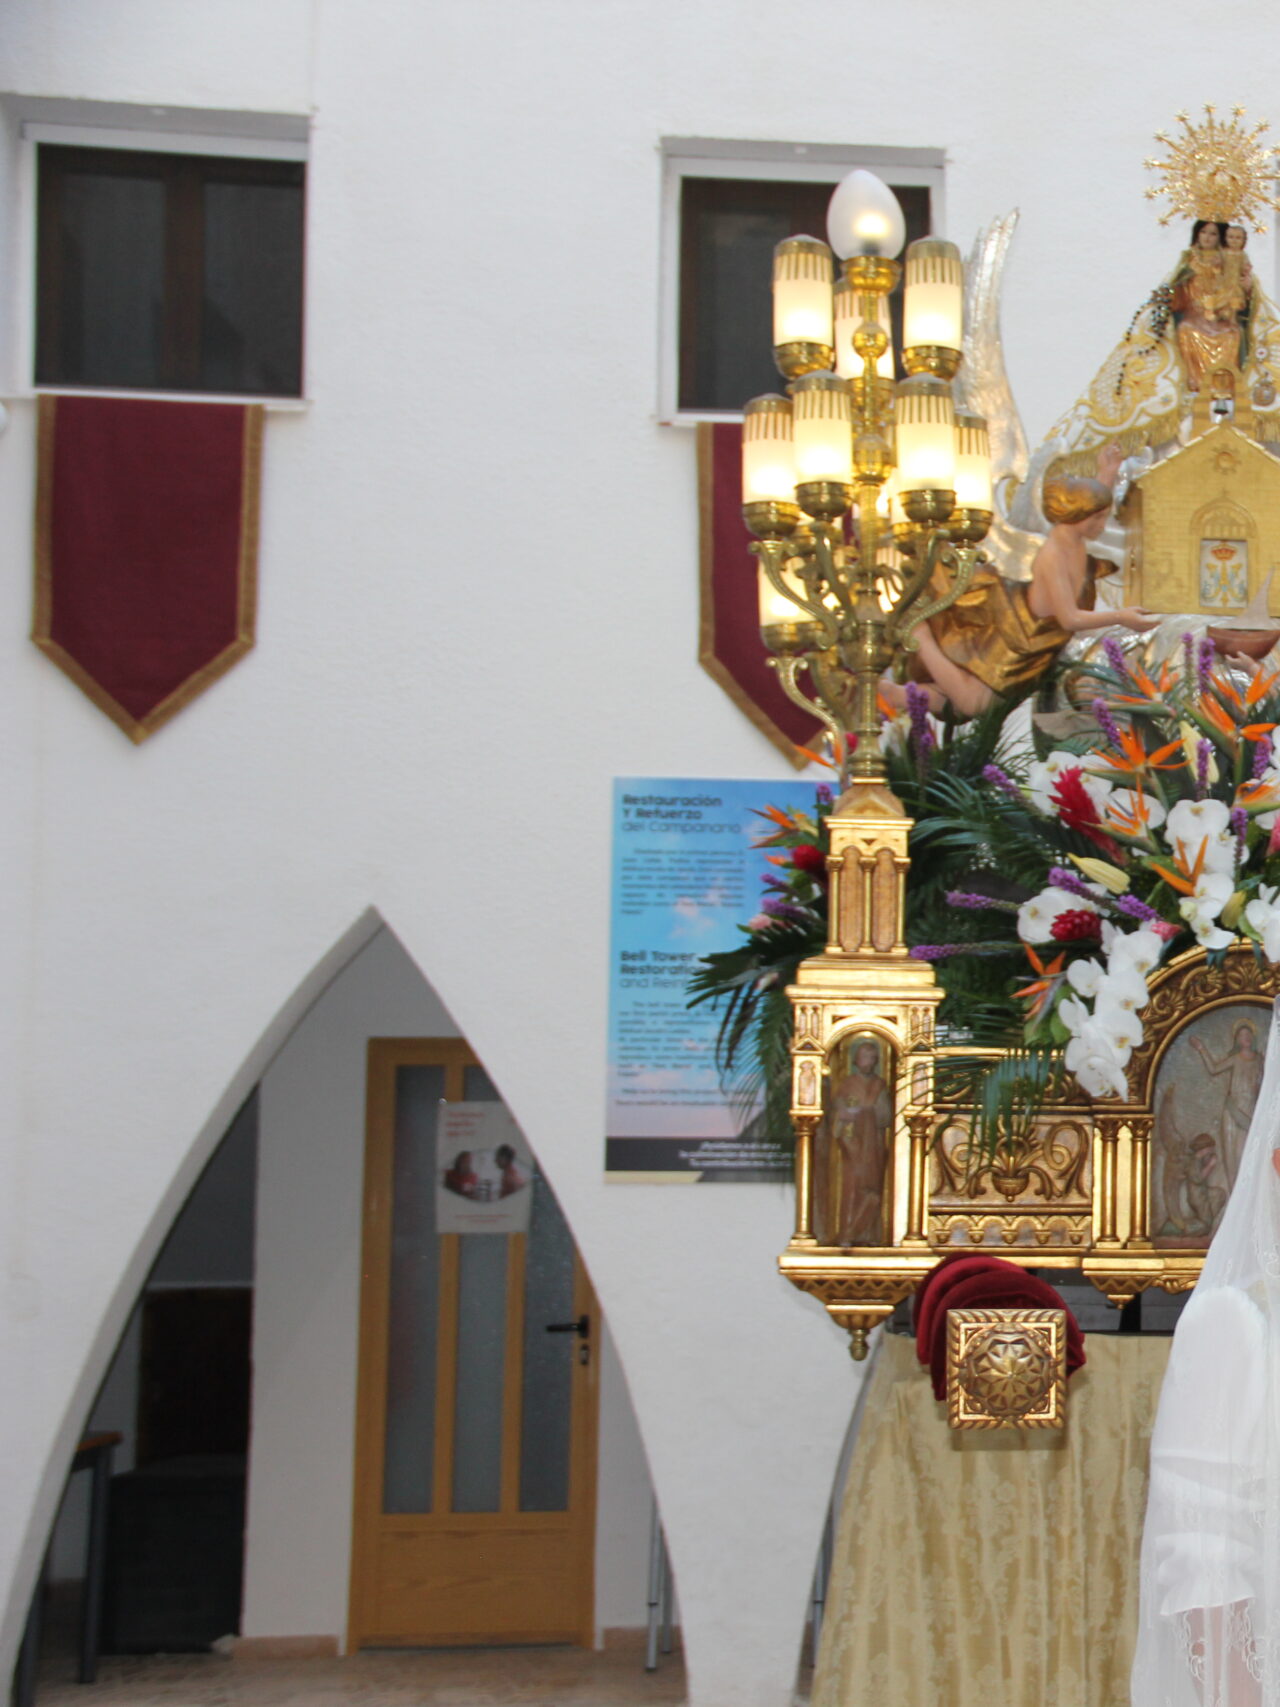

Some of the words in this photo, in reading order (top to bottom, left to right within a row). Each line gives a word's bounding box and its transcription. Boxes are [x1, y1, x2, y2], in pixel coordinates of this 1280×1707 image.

[622, 794, 723, 807] Restauración
[636, 808, 702, 820] Refuerzo
[622, 821, 644, 832] del
[650, 822, 742, 834] Campanario
[620, 952, 646, 962] Bell
[653, 952, 696, 963] Tower
[620, 978, 648, 988] and
